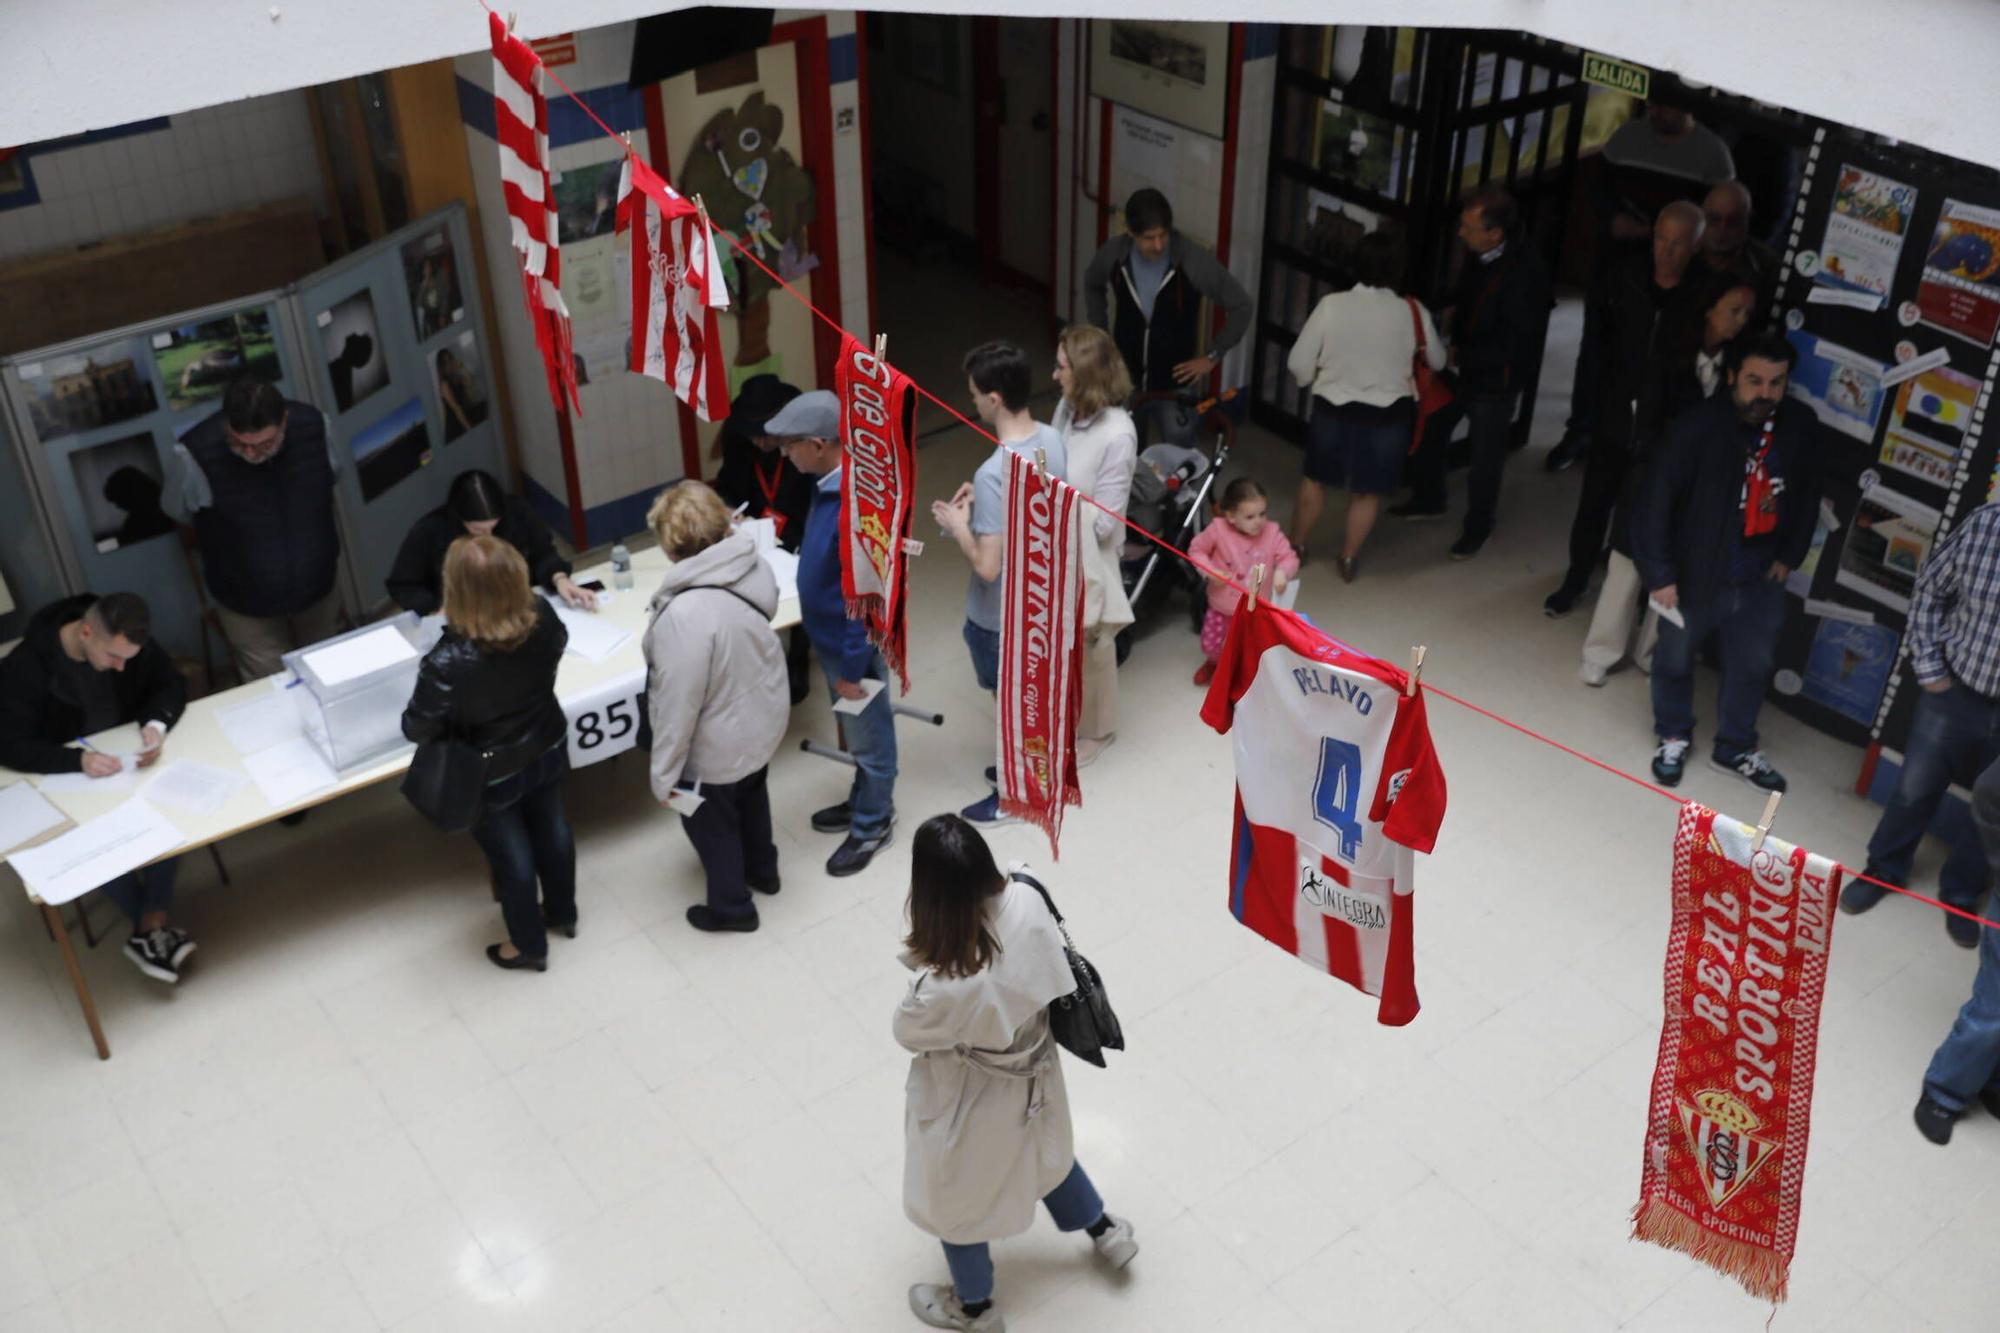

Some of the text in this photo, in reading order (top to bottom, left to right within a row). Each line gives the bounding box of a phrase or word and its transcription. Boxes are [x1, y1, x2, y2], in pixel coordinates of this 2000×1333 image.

[1588, 59, 1642, 92] SALIDA
[853, 382, 890, 428] de
[844, 427, 896, 510] Gijón
[1292, 667, 1373, 716] PELAYO
[575, 699, 633, 750] 85
[1312, 735, 1363, 864] 4
[1323, 884, 1386, 927] INTEGRA
[1797, 873, 1825, 945] PUXA
[1692, 890, 1741, 1036] REAL
[1735, 850, 1796, 1102] SPORTING
[1668, 1188, 1771, 1247] REAL SPORTING
